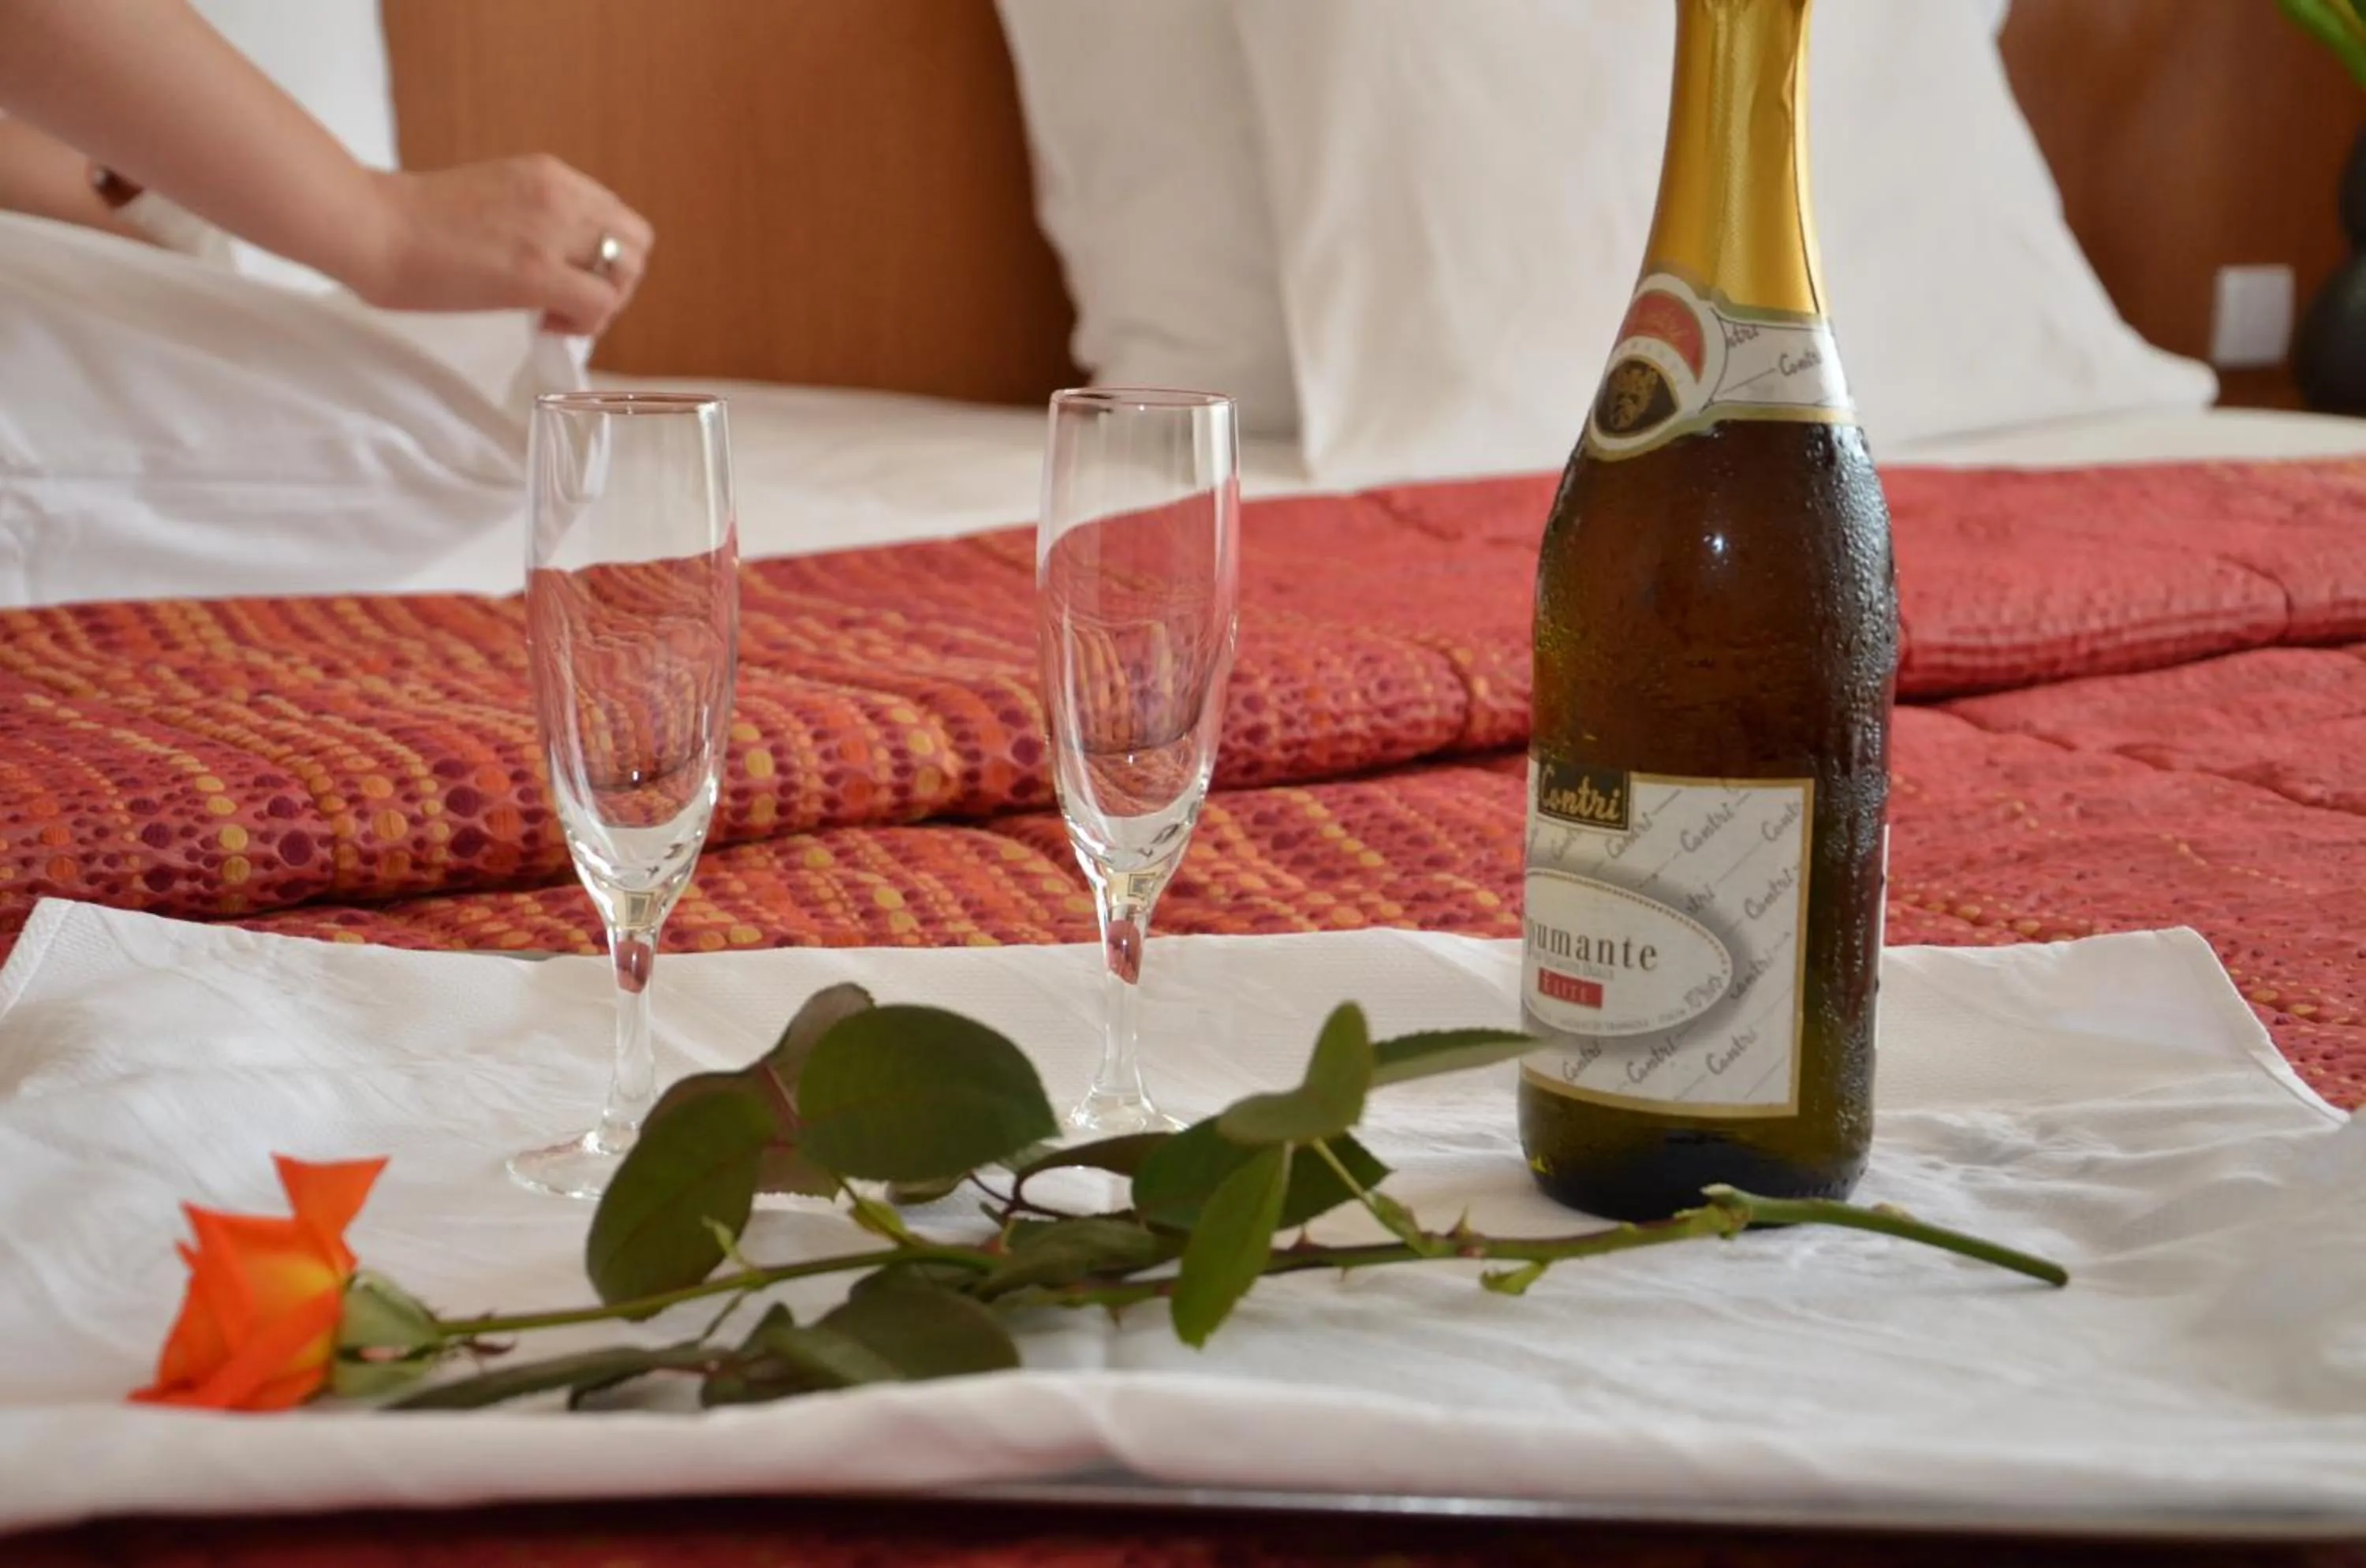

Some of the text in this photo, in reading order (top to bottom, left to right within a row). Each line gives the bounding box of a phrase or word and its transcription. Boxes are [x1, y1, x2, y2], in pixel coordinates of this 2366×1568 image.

[1542, 763, 1621, 822] Contri
[1681, 802, 1735, 853] Contri
[1744, 867, 1793, 920] Contri
[1627, 1036, 1677, 1084] Contri
[1705, 1027, 1758, 1075] Contri
